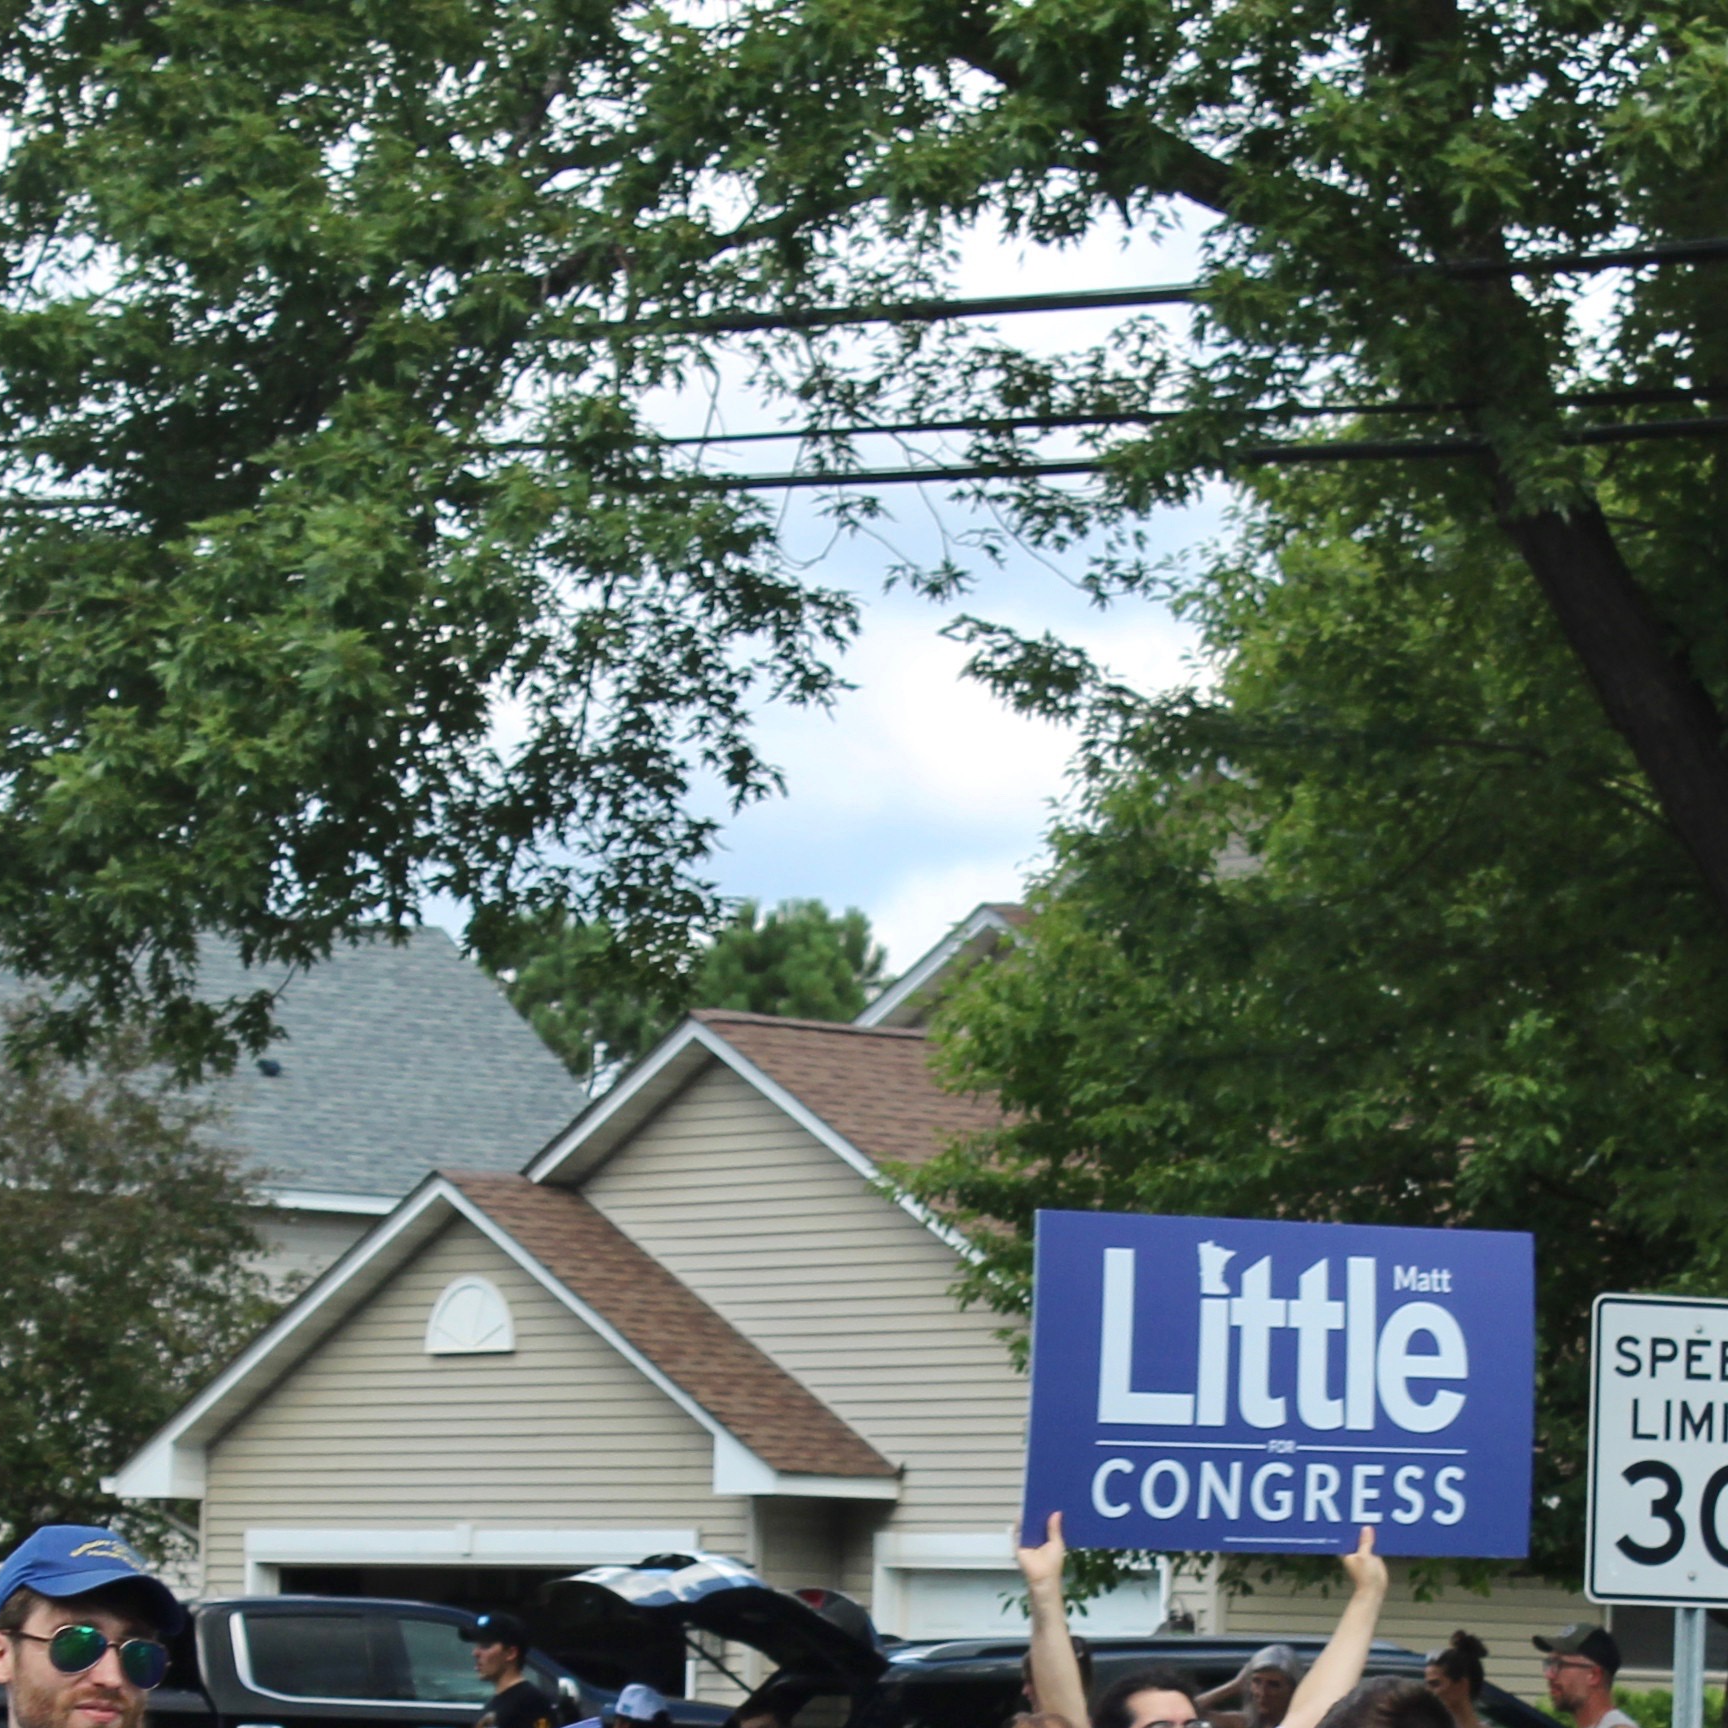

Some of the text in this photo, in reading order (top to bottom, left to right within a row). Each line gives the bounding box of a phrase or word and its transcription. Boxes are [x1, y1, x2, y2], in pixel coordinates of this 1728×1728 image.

[1393, 1264, 1453, 1294] Matt
[1097, 1240, 1469, 1433] Little
[1267, 1439, 1297, 1454] FOR
[1092, 1458, 1467, 1526] CONGRESS
